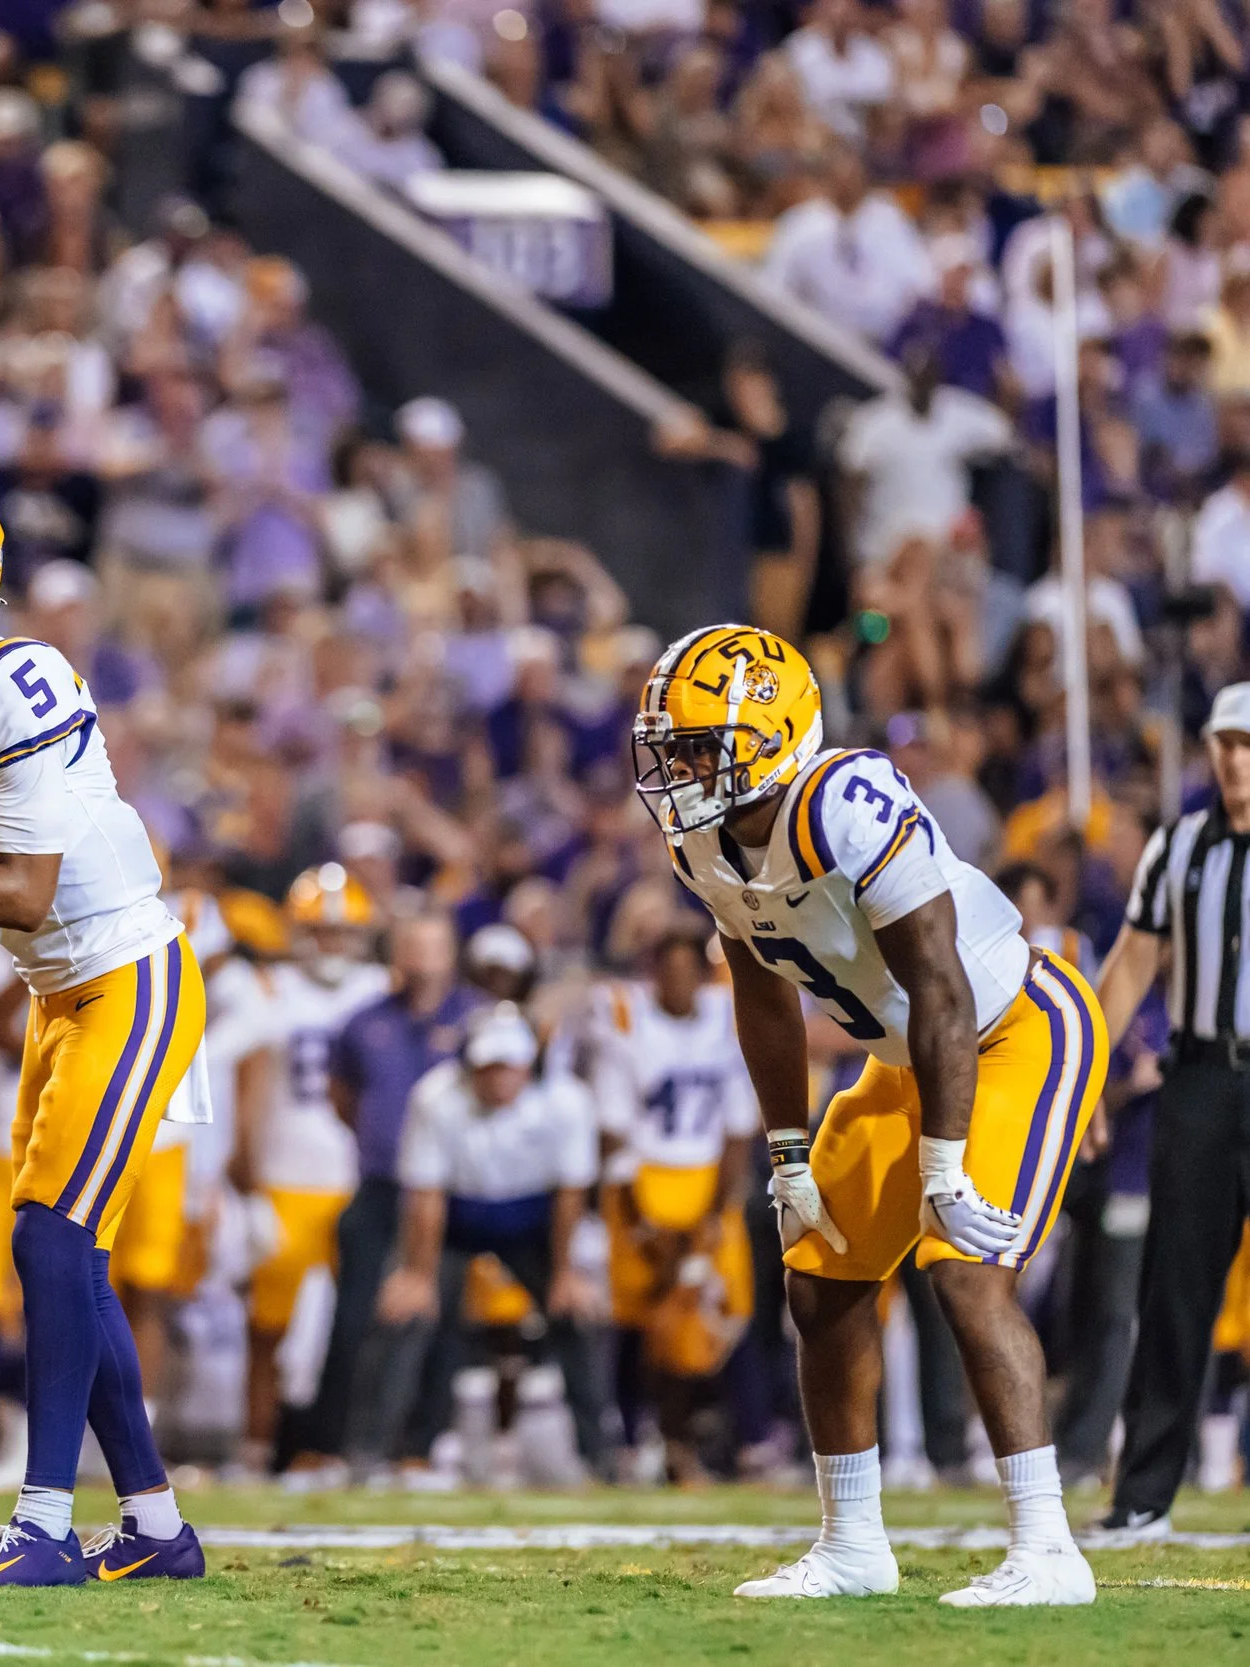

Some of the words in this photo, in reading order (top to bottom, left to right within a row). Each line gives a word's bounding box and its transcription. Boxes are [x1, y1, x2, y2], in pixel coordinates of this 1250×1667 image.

[10, 658, 58, 719] 5
[693, 636, 786, 697] LSU
[842, 775, 894, 823] 3
[751, 935, 887, 1040] 3
